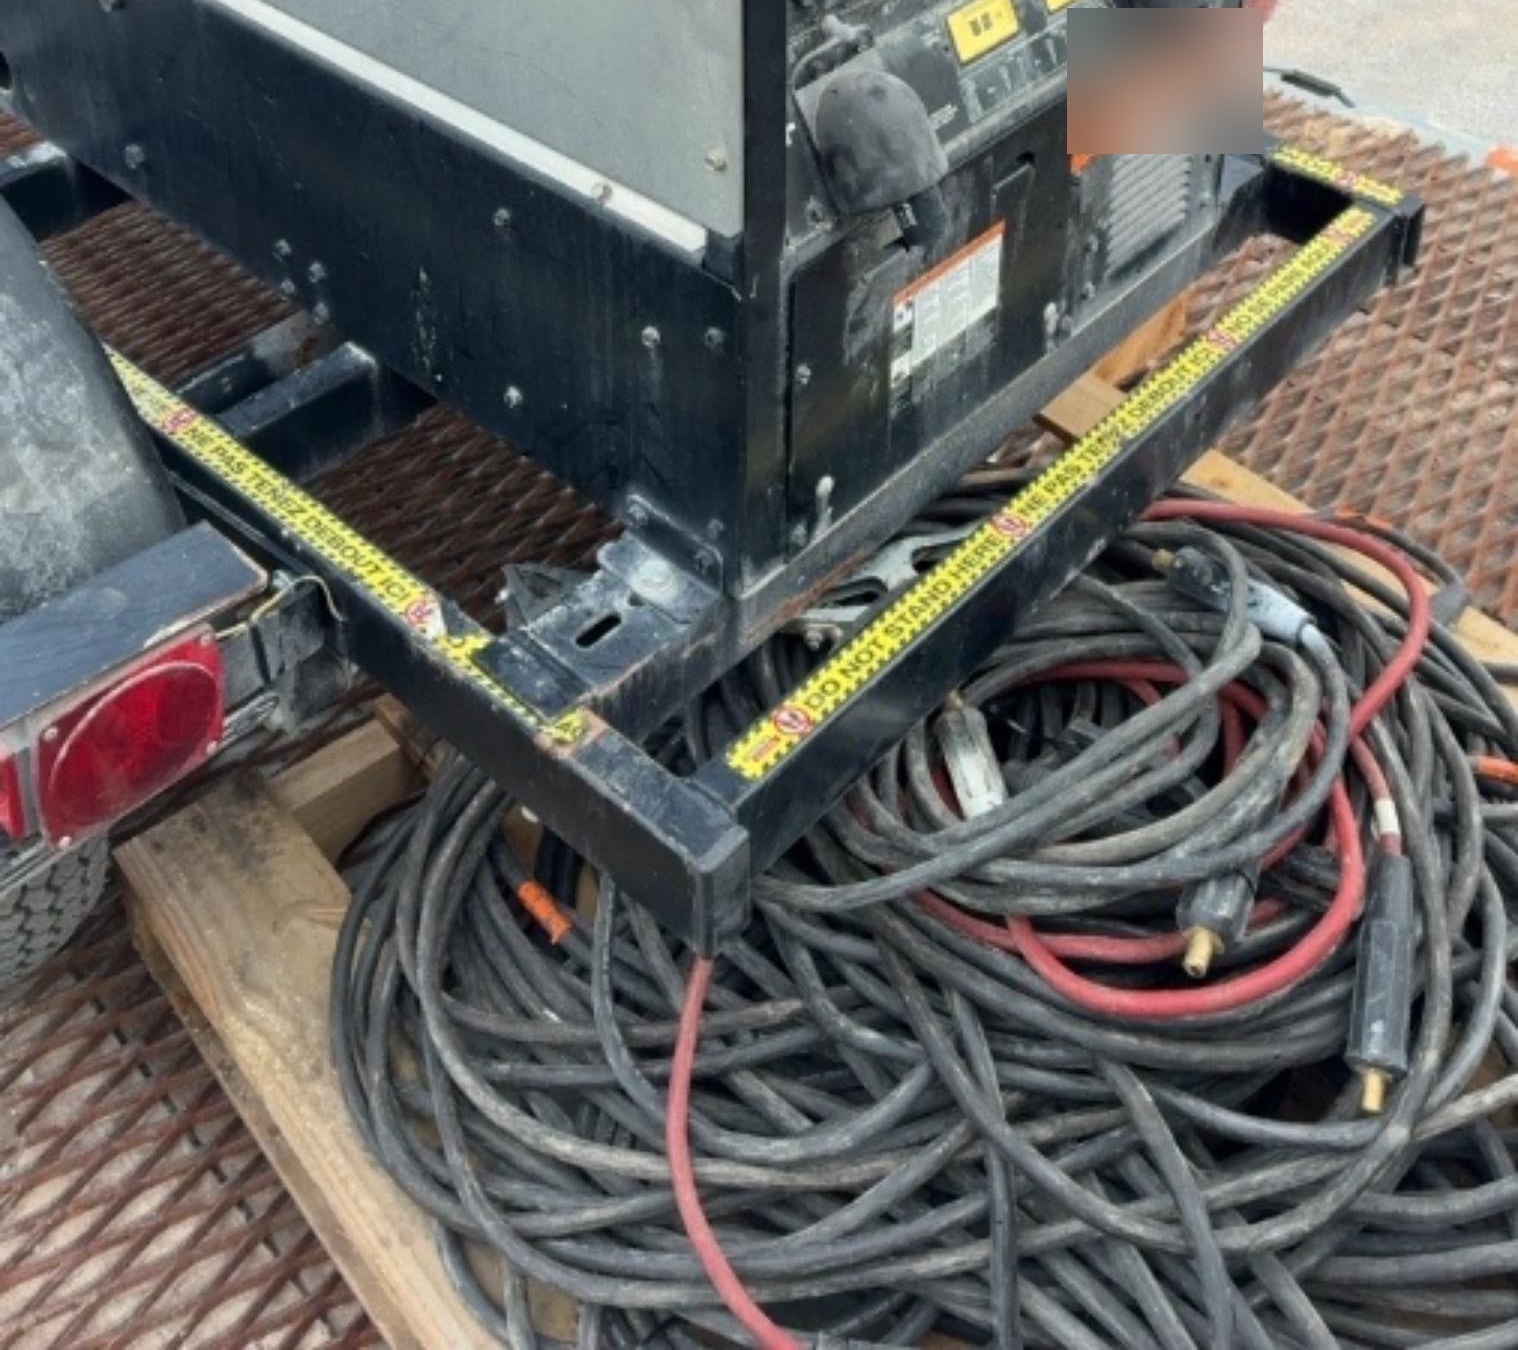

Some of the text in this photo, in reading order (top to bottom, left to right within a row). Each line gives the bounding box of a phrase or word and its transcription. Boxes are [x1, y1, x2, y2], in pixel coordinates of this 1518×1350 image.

[209, 445, 249, 475] PAS
[249, 475, 306, 519] TENEZ
[302, 515, 383, 575] DEBOUT
[378, 576, 411, 601] ICI
[1042, 460, 1083, 498] PAS
[804, 533, 1002, 709] DO NOT STAND HERE
